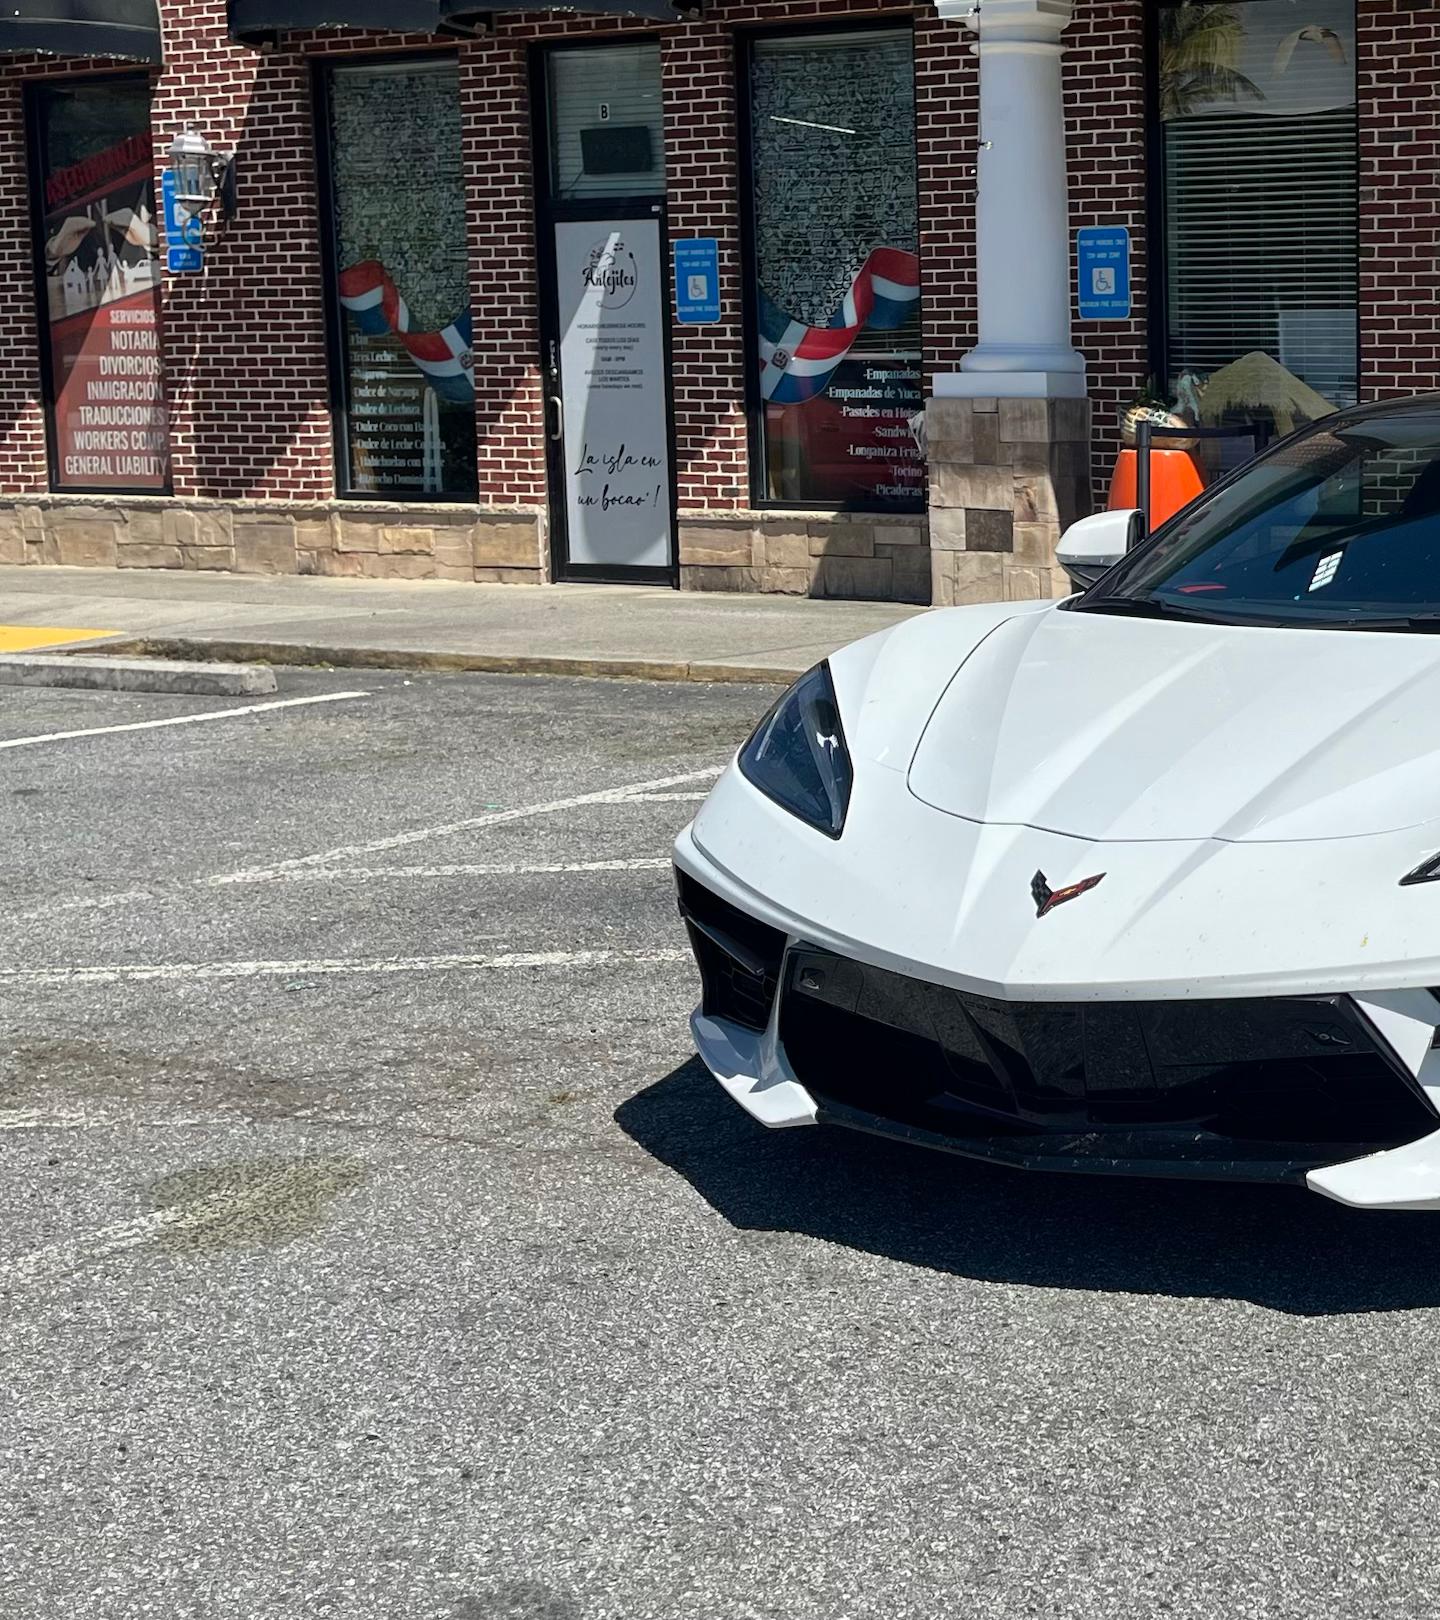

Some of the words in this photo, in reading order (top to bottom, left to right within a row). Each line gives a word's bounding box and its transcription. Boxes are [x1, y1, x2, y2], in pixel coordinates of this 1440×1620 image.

[601, 104, 608, 119] B
[100, 356, 161, 376] DIVORCIOS
[87, 375, 163, 400] INMIGRACIÓN
[78, 406, 165, 426] TRADUCCIONES
[74, 431, 129, 450] WORKERS
[65, 456, 114, 475] GENERAL
[116, 456, 167, 475] LIABILITY
[574, 443, 600, 475] La
[641, 455, 662, 468] en
[577, 495, 598, 506] un
